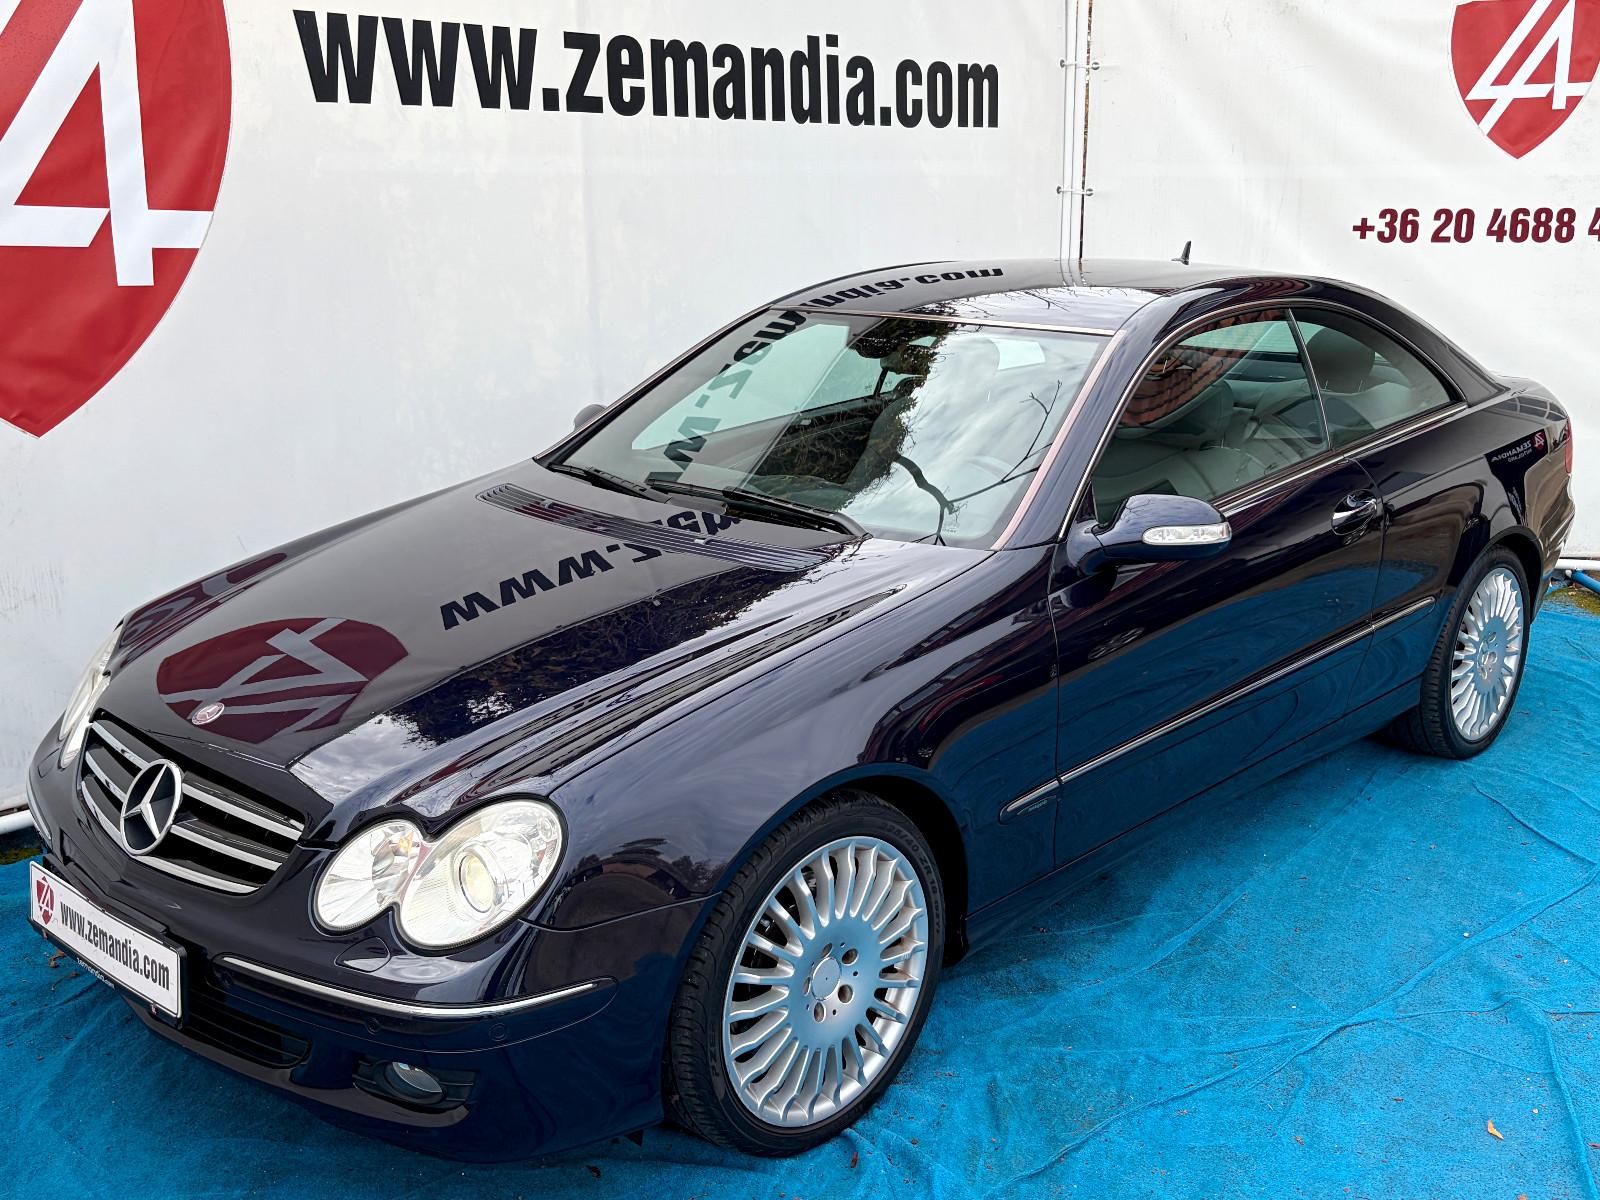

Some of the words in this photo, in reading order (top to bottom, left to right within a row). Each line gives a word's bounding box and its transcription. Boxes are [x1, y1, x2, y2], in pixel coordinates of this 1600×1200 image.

[293, 10, 998, 128] www.zemandia.com
[1352, 208, 1419, 243] +36
[1431, 208, 1475, 243] 20
[1486, 207, 1576, 243] 4688
[60, 901, 170, 991] www.zemandia.com
